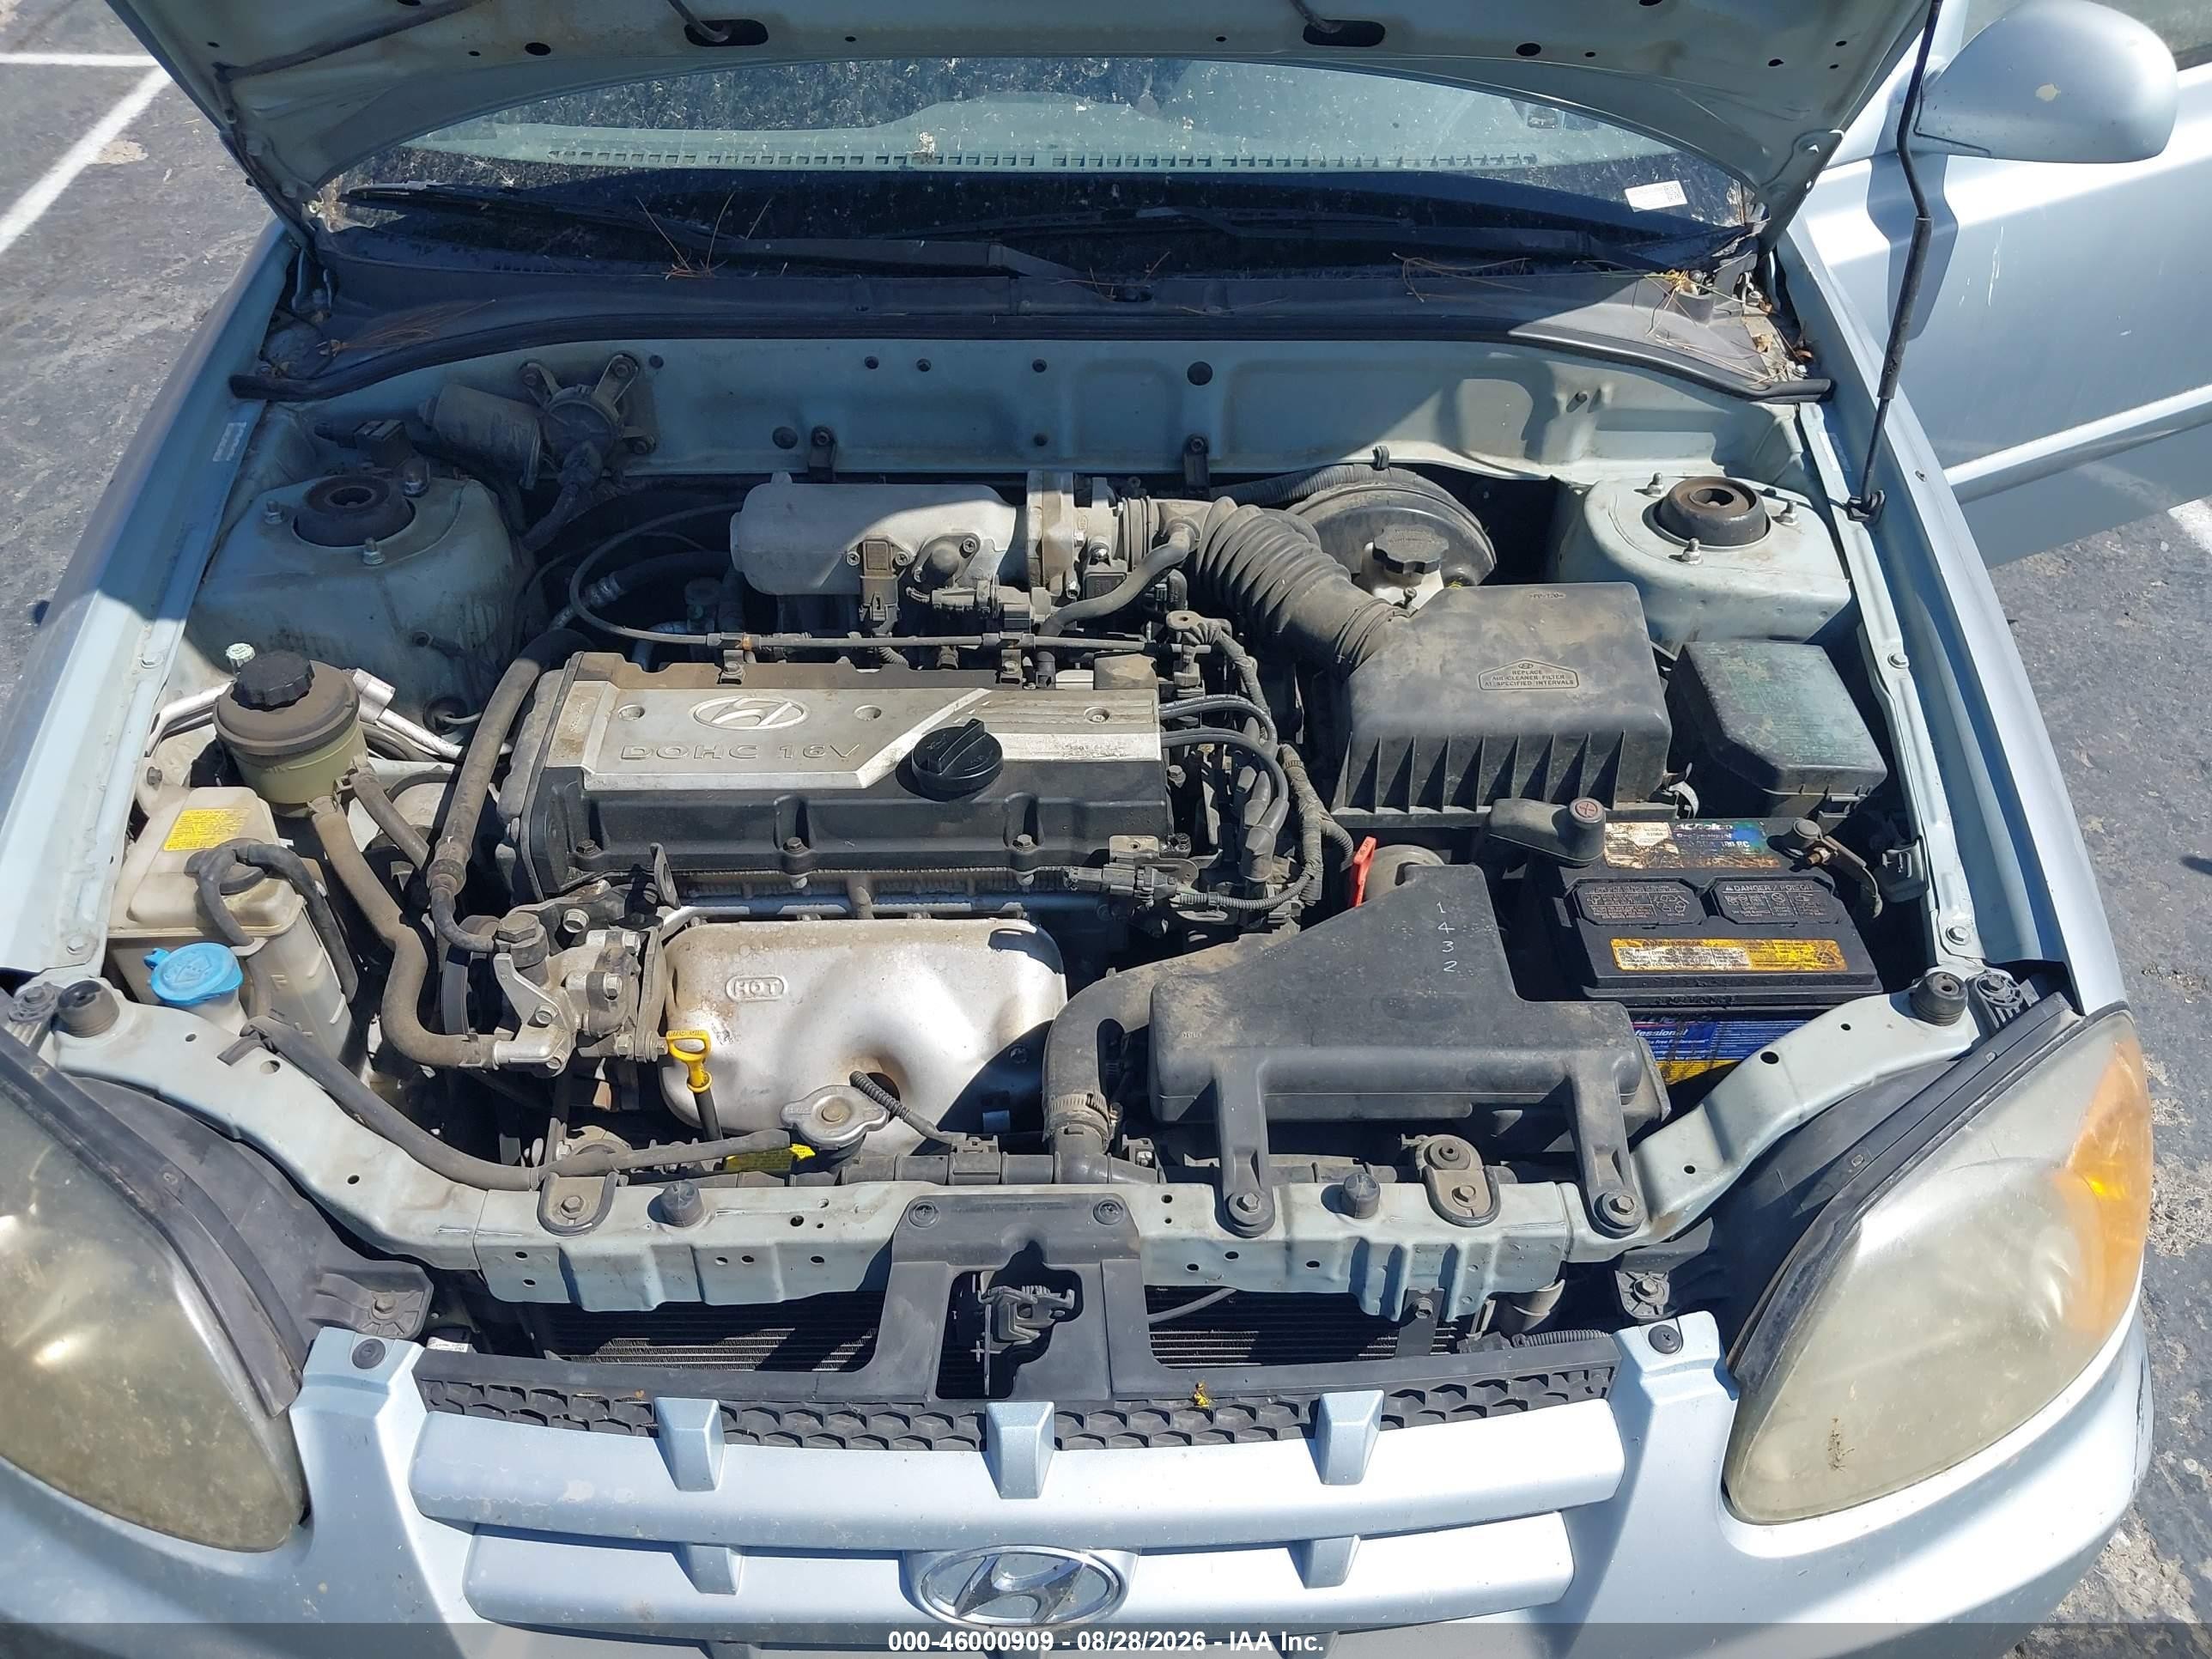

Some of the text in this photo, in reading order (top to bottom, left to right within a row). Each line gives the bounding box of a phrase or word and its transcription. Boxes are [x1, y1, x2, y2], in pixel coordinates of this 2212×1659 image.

[620, 744, 860, 760] DOHC 16V
[733, 979, 781, 997] HOT
